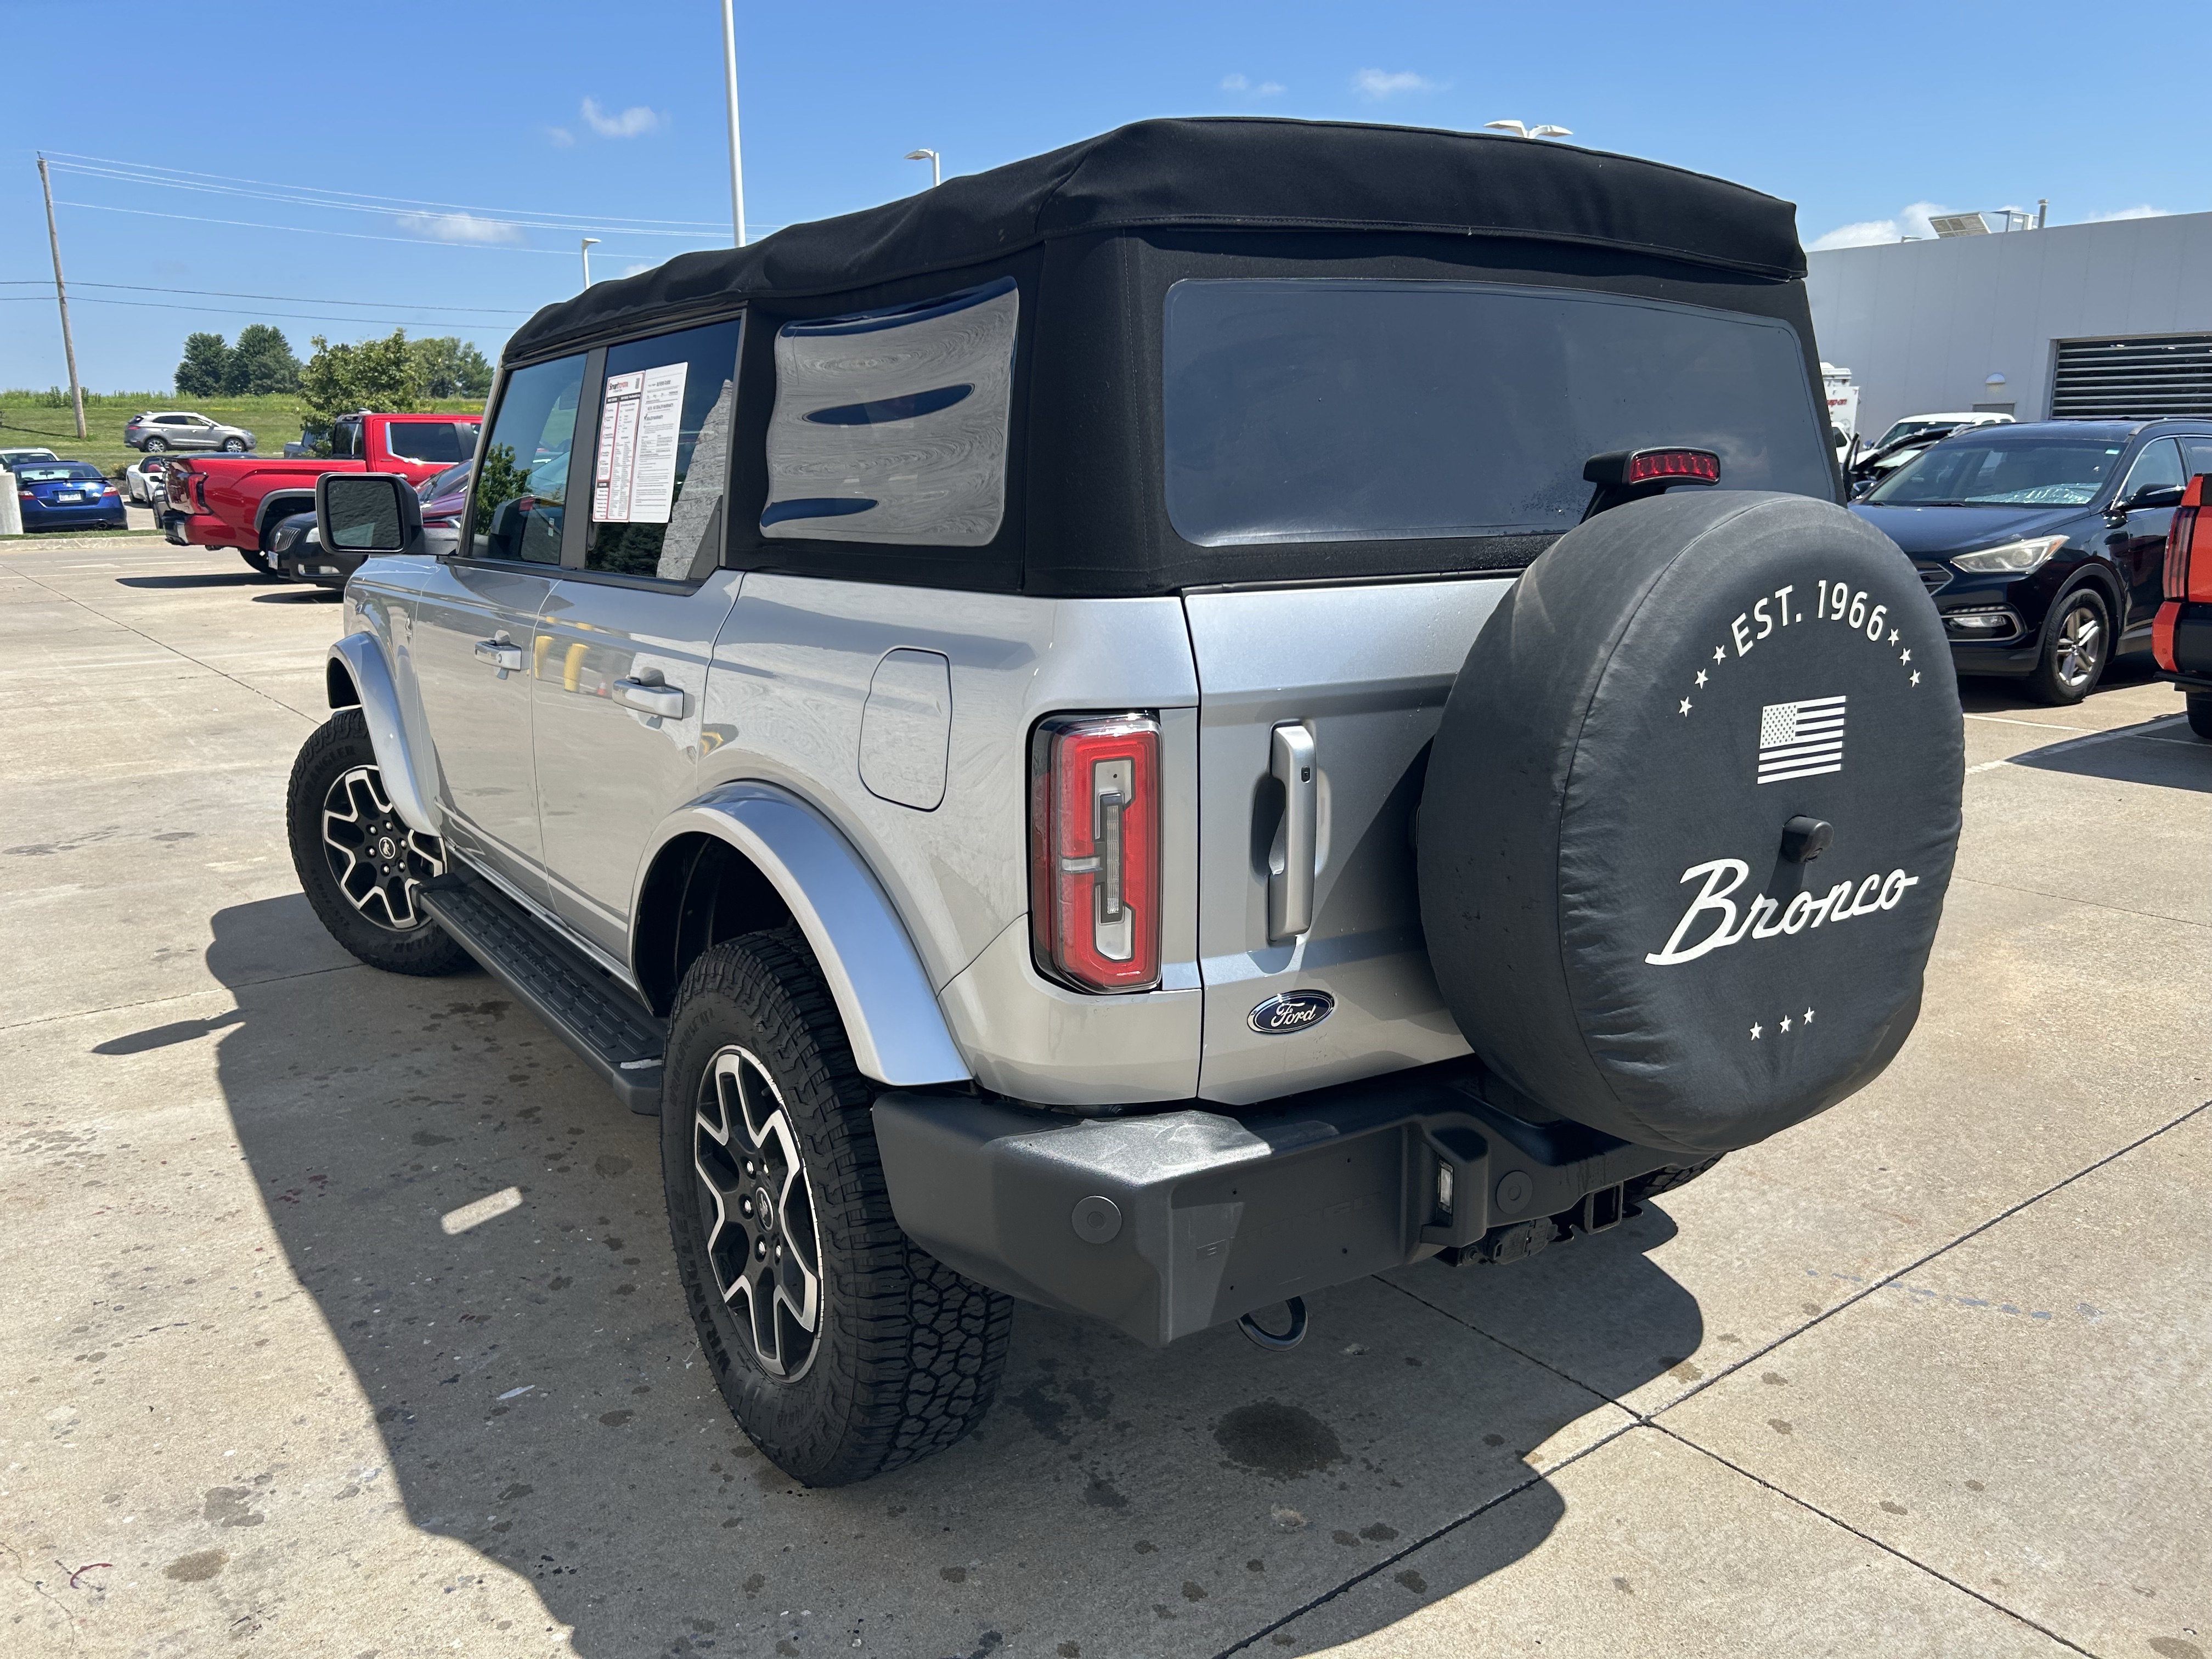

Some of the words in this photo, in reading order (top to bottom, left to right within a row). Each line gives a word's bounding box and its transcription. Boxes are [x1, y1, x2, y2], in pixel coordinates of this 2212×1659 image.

[1731, 585, 1802, 657] EST.
[1817, 580, 1887, 641] 1966
[1644, 858, 1919, 966] Bronco
[1271, 1002, 1317, 1027] Ford
[670, 1189, 732, 1378] WRANGLER
